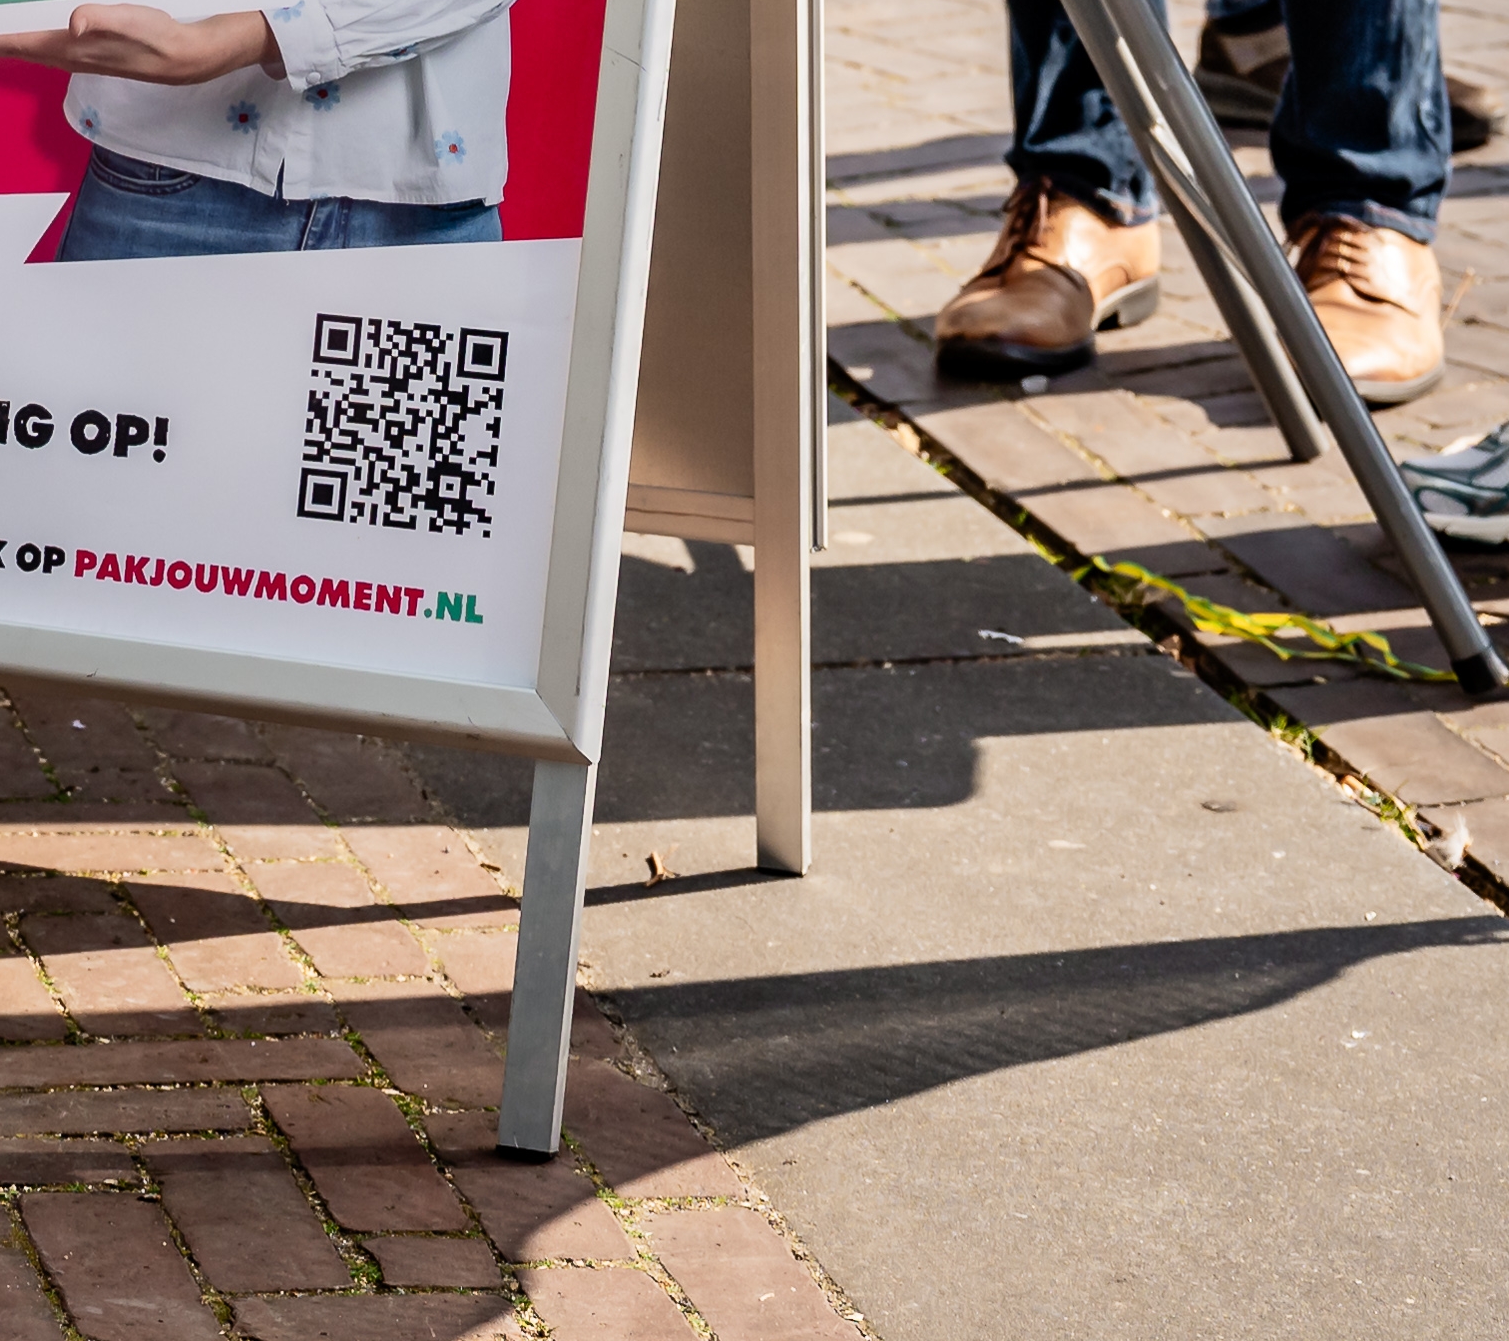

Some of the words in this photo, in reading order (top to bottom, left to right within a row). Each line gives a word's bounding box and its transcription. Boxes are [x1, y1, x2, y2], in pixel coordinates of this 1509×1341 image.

[69, 409, 170, 464] OP!
[15, 542, 66, 574] OP
[74, 549, 484, 624] PAKJOUWMOMENT.NL
